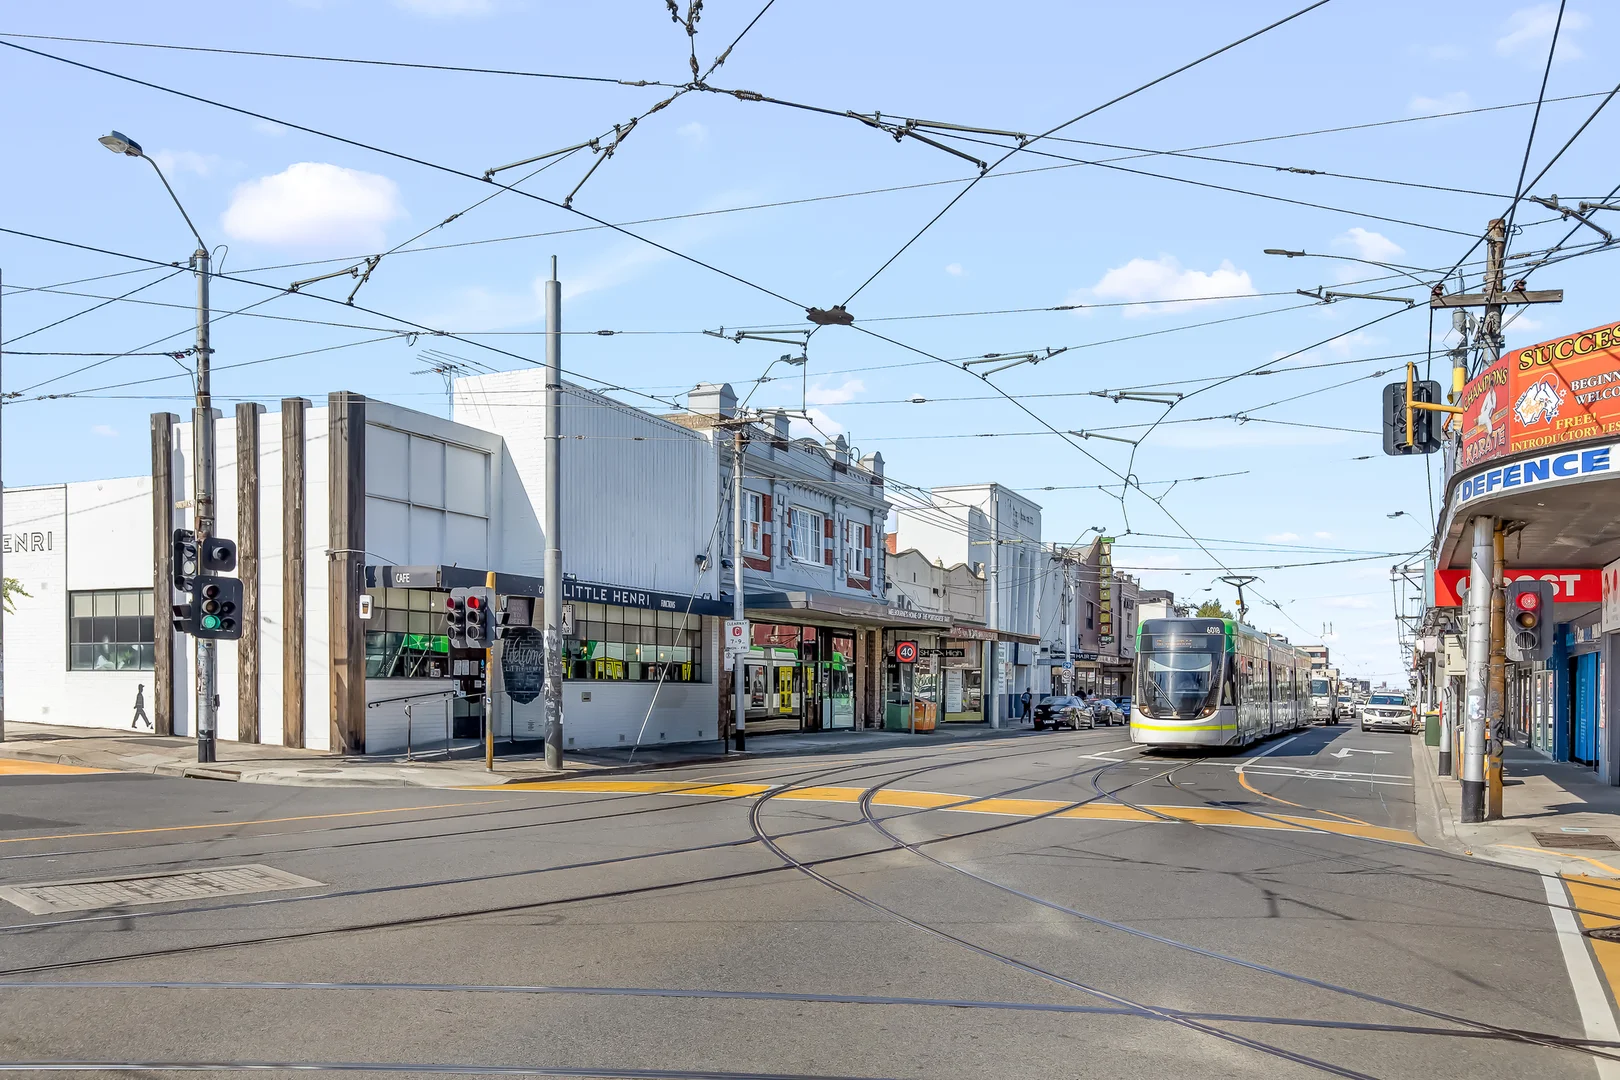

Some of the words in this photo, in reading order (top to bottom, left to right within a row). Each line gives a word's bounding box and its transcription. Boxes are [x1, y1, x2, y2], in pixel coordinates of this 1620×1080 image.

[1556, 412, 1597, 430] FREE!
[1465, 423, 1506, 464] KARATE
[1511, 425, 1599, 452] INTRODUCTORY
[1462, 447, 1610, 502] DEFENCE
[396, 573, 410, 583] CAFE
[563, 584, 608, 601] LITTLE
[613, 590, 650, 606] HENRI
[901, 647, 914, 657] 40
